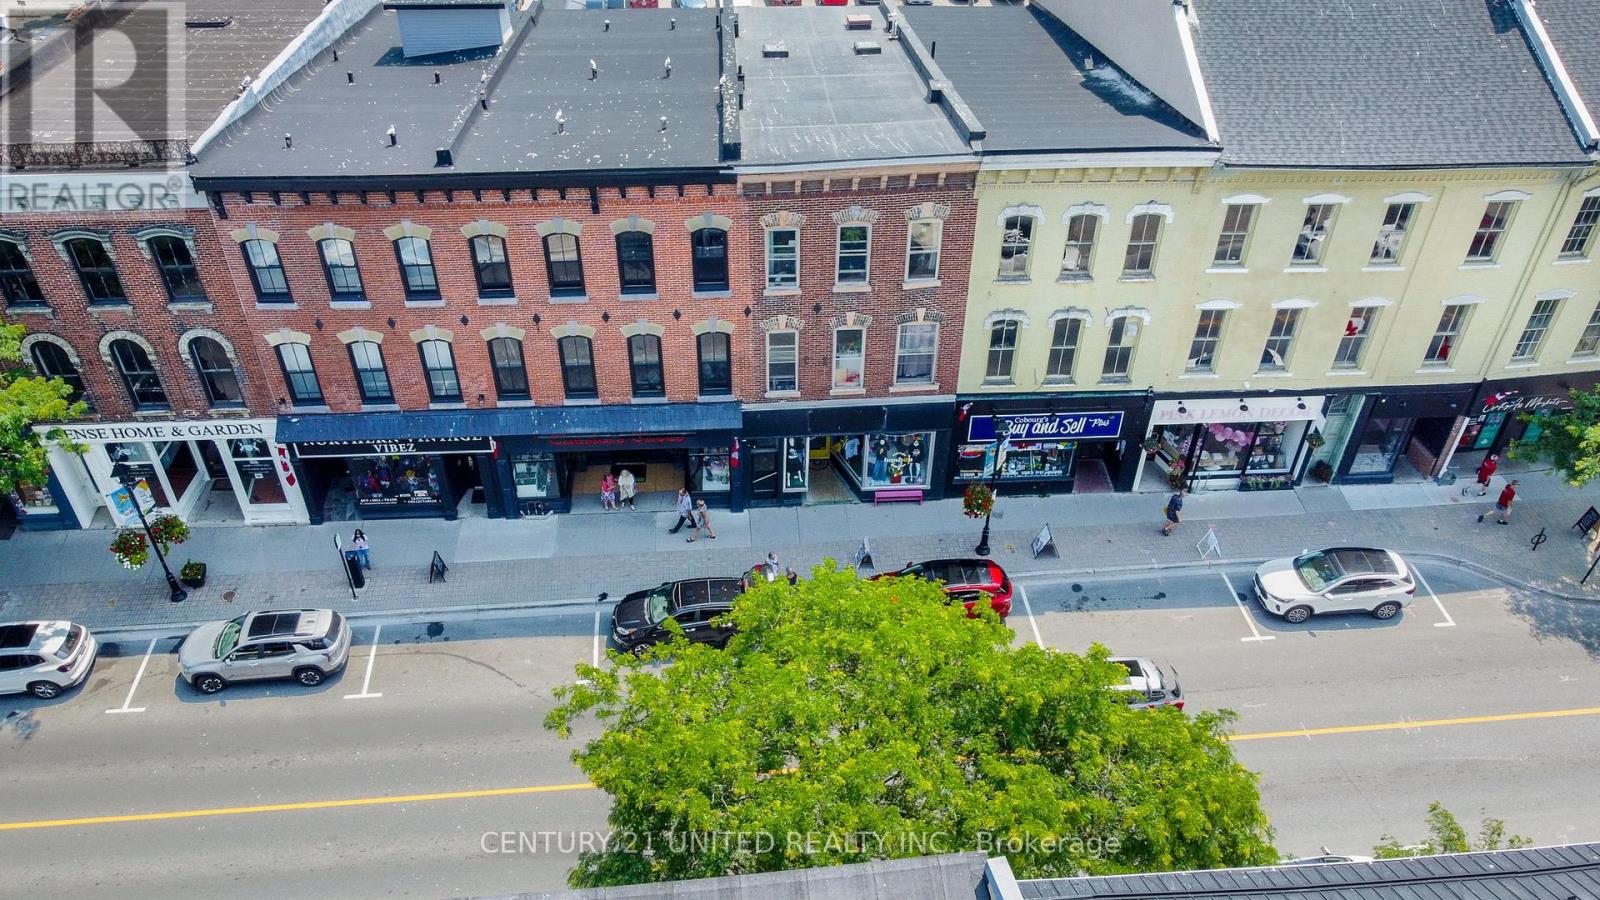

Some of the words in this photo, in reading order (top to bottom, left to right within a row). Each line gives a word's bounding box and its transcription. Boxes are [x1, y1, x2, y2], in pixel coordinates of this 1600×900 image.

[1014, 416, 1049, 424] Cobourg's
[1031, 417, 1059, 434] and
[1060, 416, 1087, 434] Sell
[113, 427, 165, 438] HOME
[170, 426, 184, 437] &
[188, 423, 263, 435] GARDEN
[373, 443, 416, 453] VIBEZ
